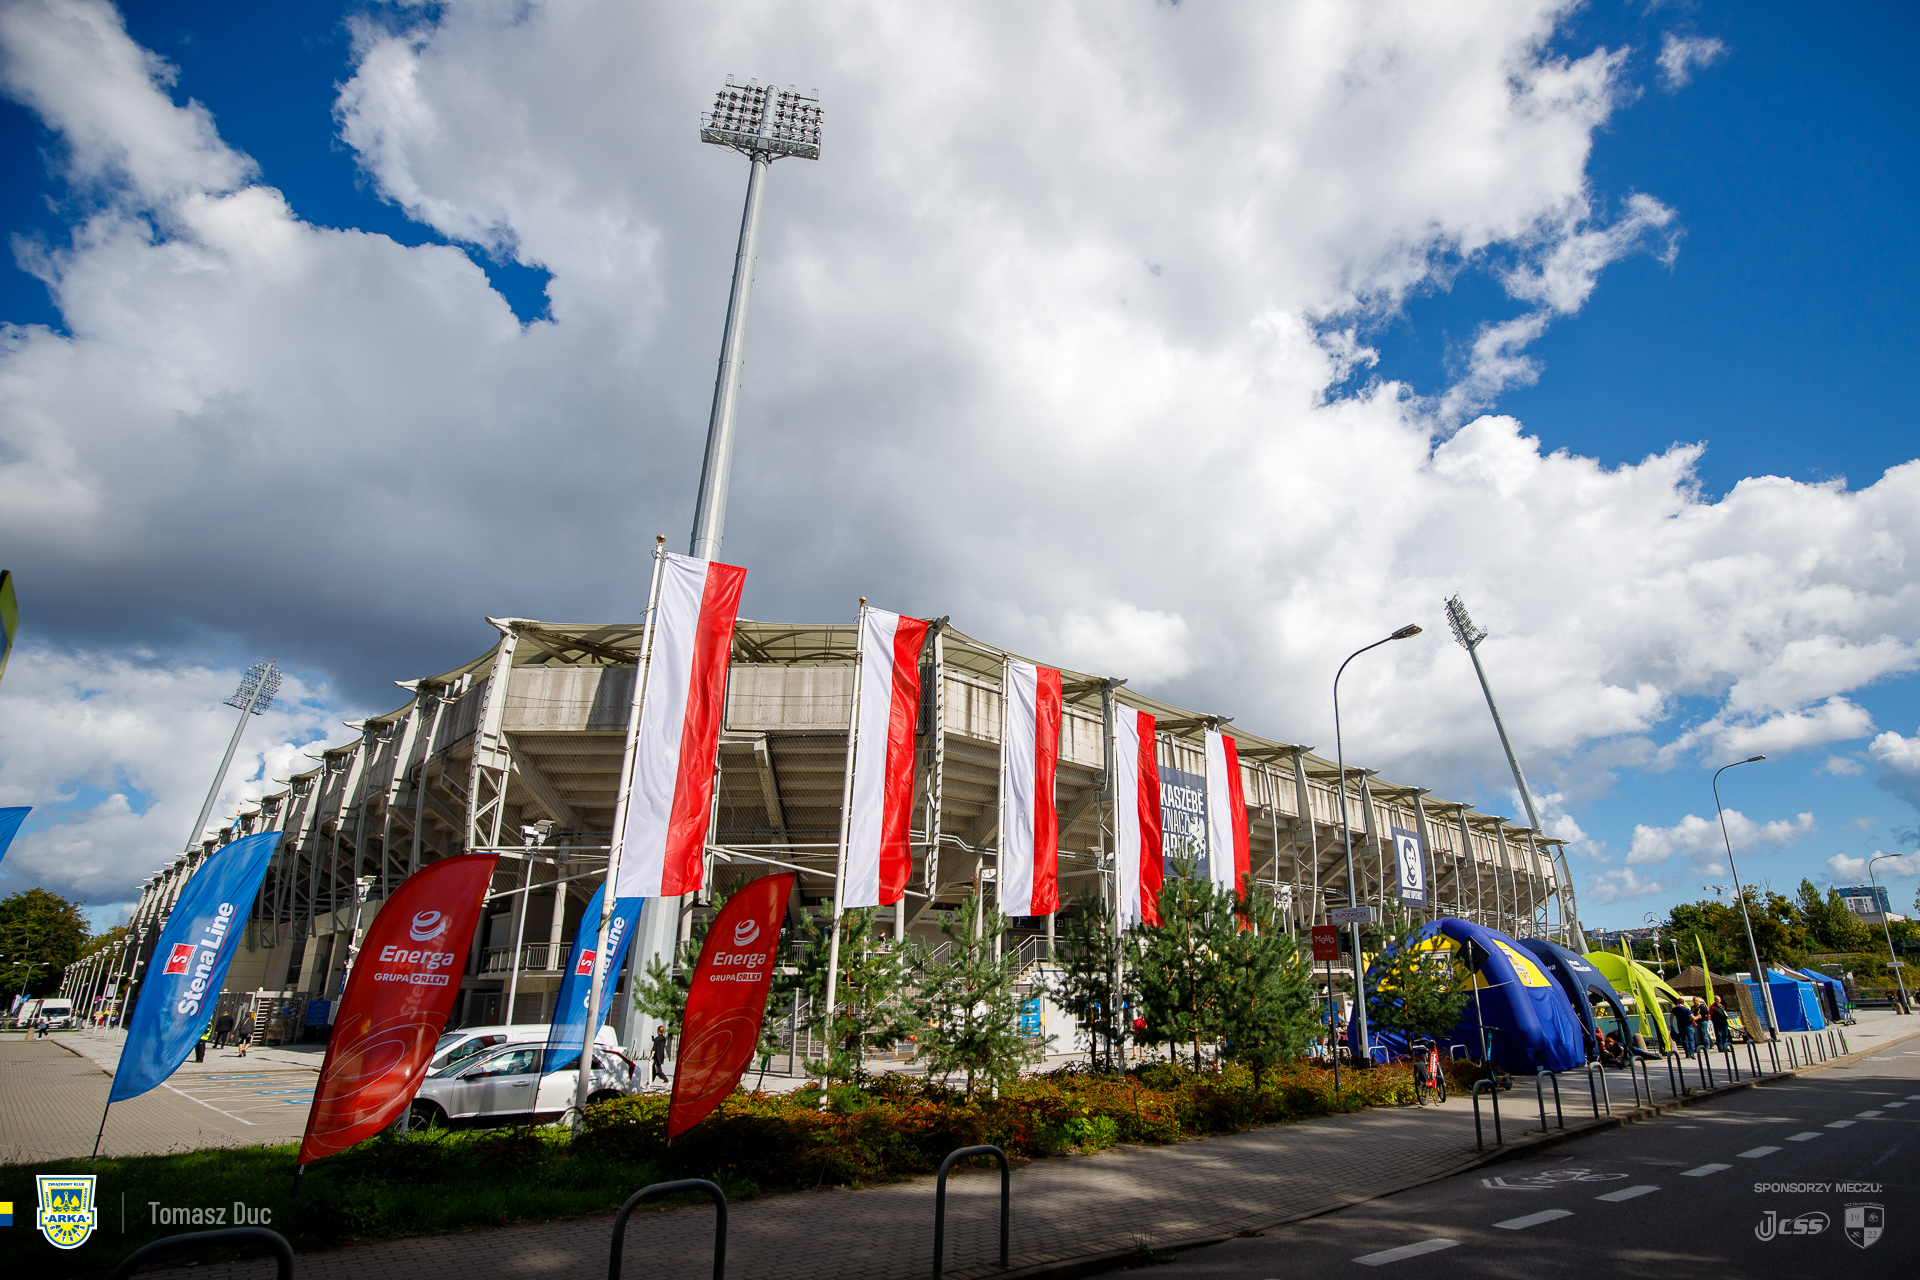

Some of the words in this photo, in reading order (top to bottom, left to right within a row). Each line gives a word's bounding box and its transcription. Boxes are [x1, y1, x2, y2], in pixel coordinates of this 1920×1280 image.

[379, 945, 455, 970] Energa
[712, 951, 766, 969] Energa
[374, 973, 409, 982] GRUPA
[411, 975, 447, 984] ORLEN
[710, 974, 735, 982] GRUPA
